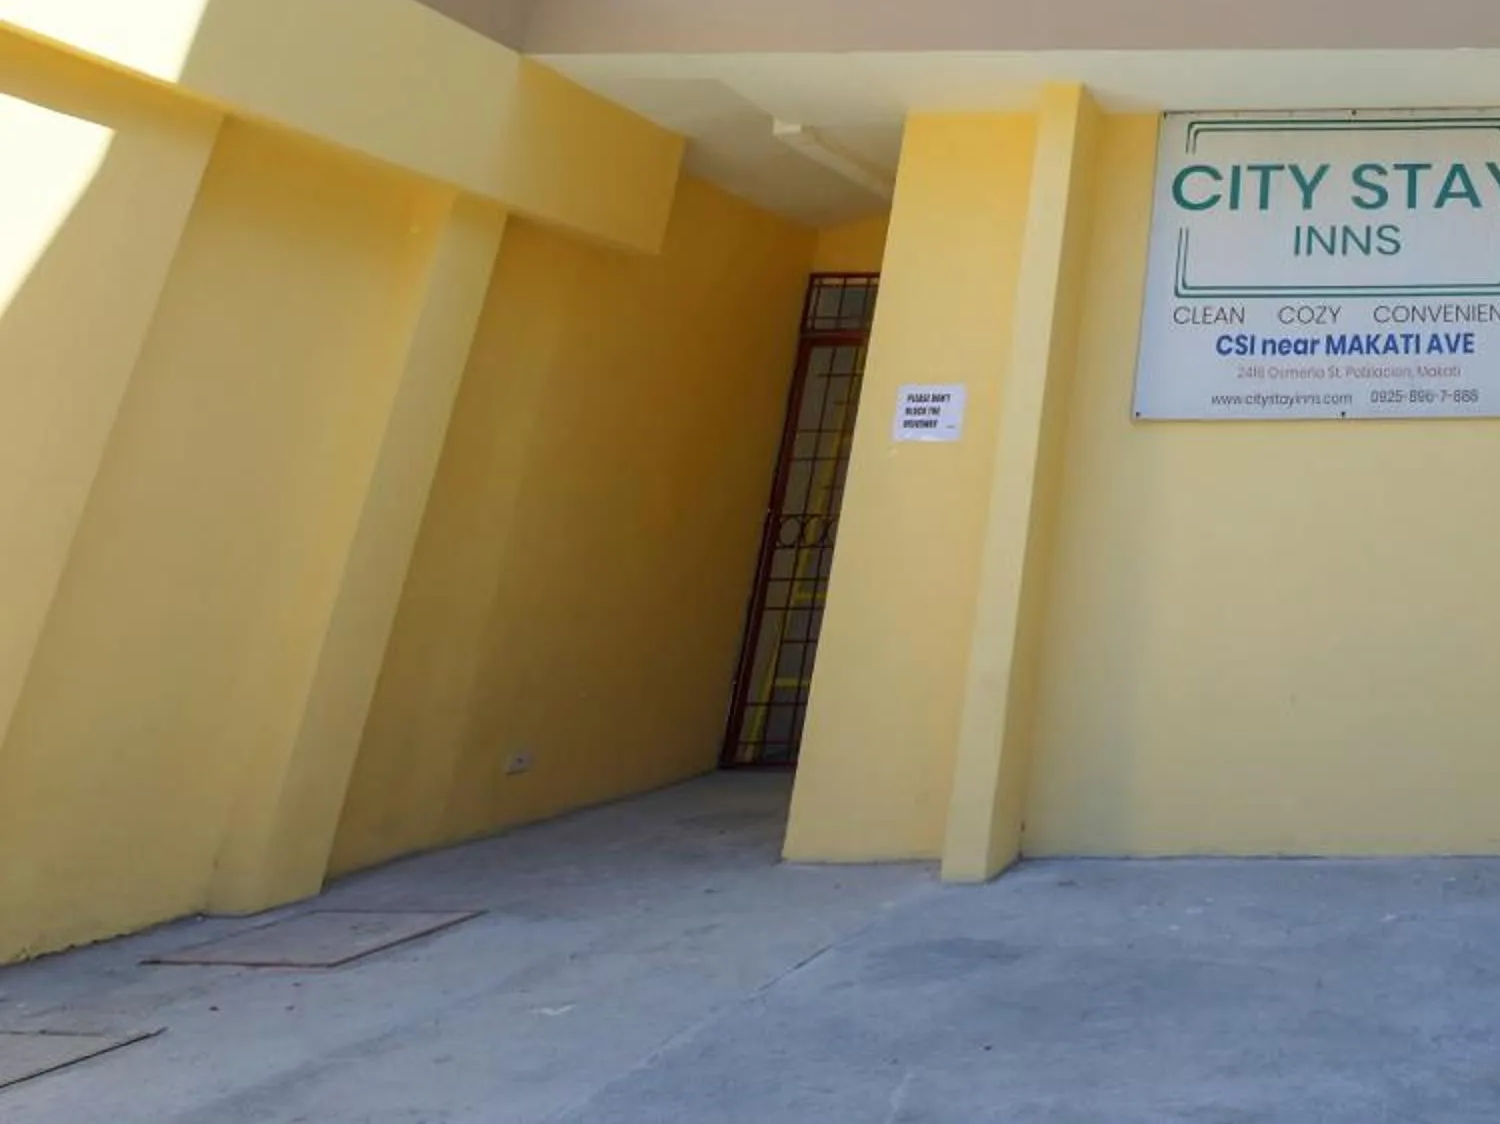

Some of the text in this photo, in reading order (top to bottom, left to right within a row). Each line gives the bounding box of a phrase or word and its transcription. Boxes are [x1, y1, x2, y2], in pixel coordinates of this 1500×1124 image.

[1172, 163, 1331, 211] CITY
[1294, 225, 1401, 256] INNS
[1173, 306, 1245, 325] CLEAN
[1278, 305, 1342, 325] COZY
[1215, 332, 1476, 356] CSI near MAKATI AVE
